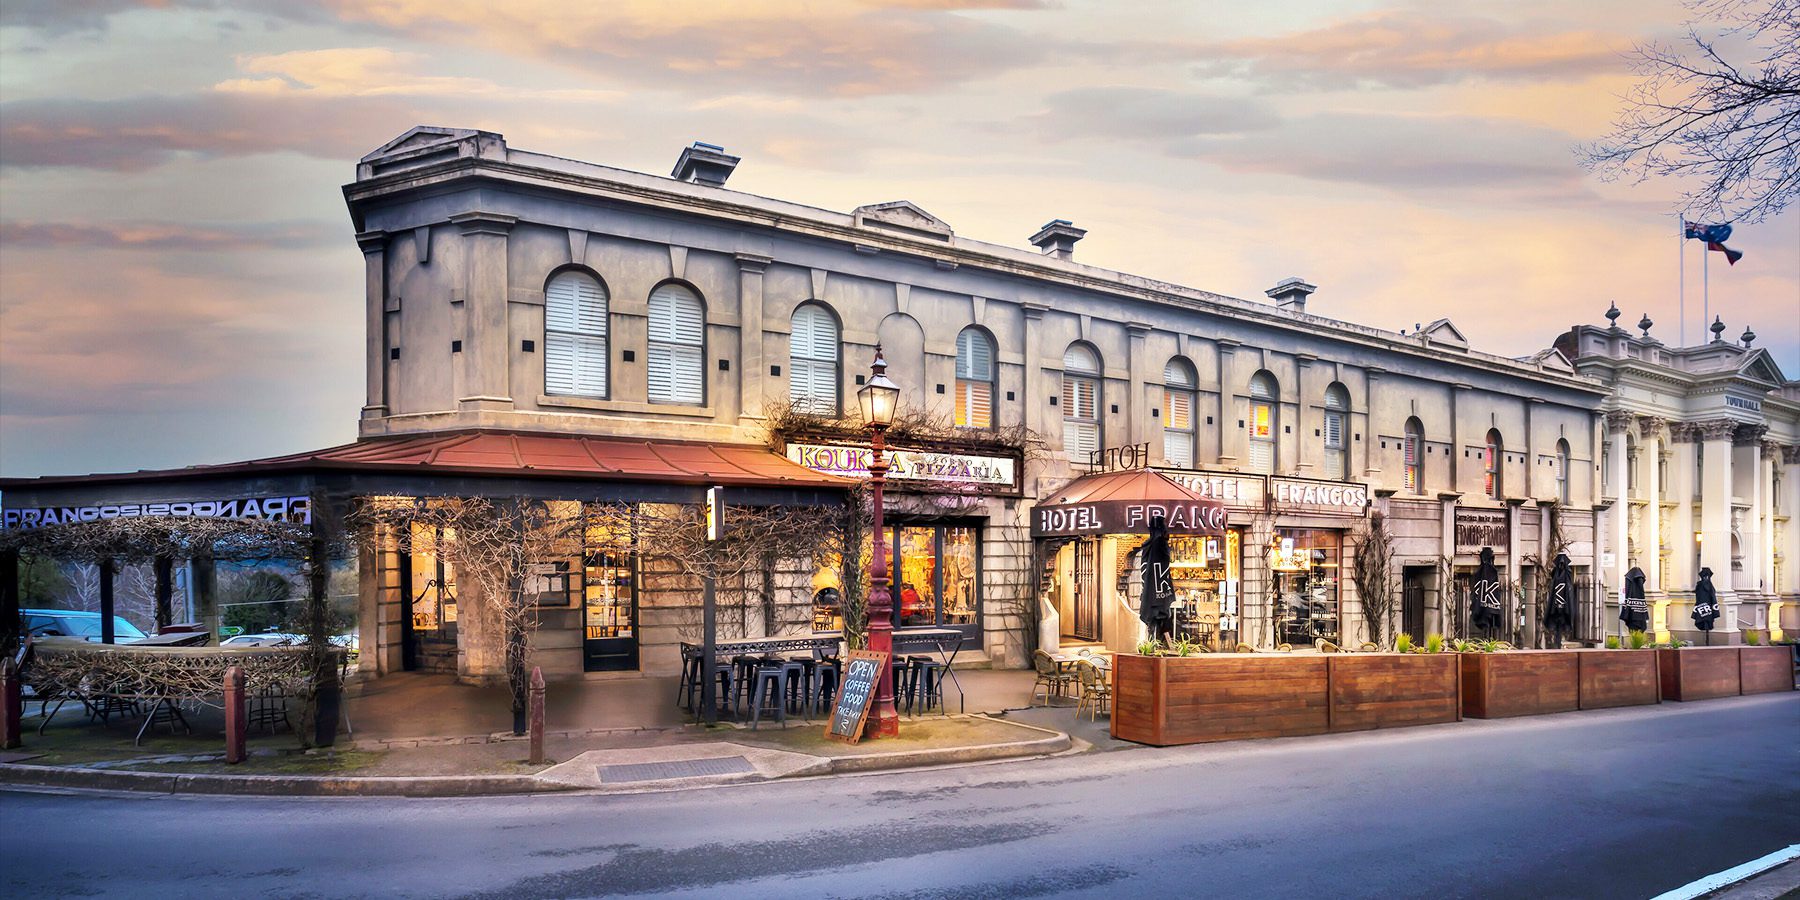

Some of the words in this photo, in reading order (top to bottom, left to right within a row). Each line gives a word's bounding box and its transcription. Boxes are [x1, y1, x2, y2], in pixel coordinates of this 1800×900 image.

[1725, 395, 1743, 408] TOWN
[1743, 399, 1760, 411] HALL
[798, 446, 905, 473] KOUKA
[914, 462, 1003, 479] PIZZARIA
[1276, 483, 1367, 507] FRANGOS
[4, 505, 140, 529] FRANGOS
[1041, 506, 1102, 532] HOTEL
[849, 660, 878, 677] OPEN
[845, 679, 870, 692] COFFEE
[843, 692, 863, 705] FOOD
